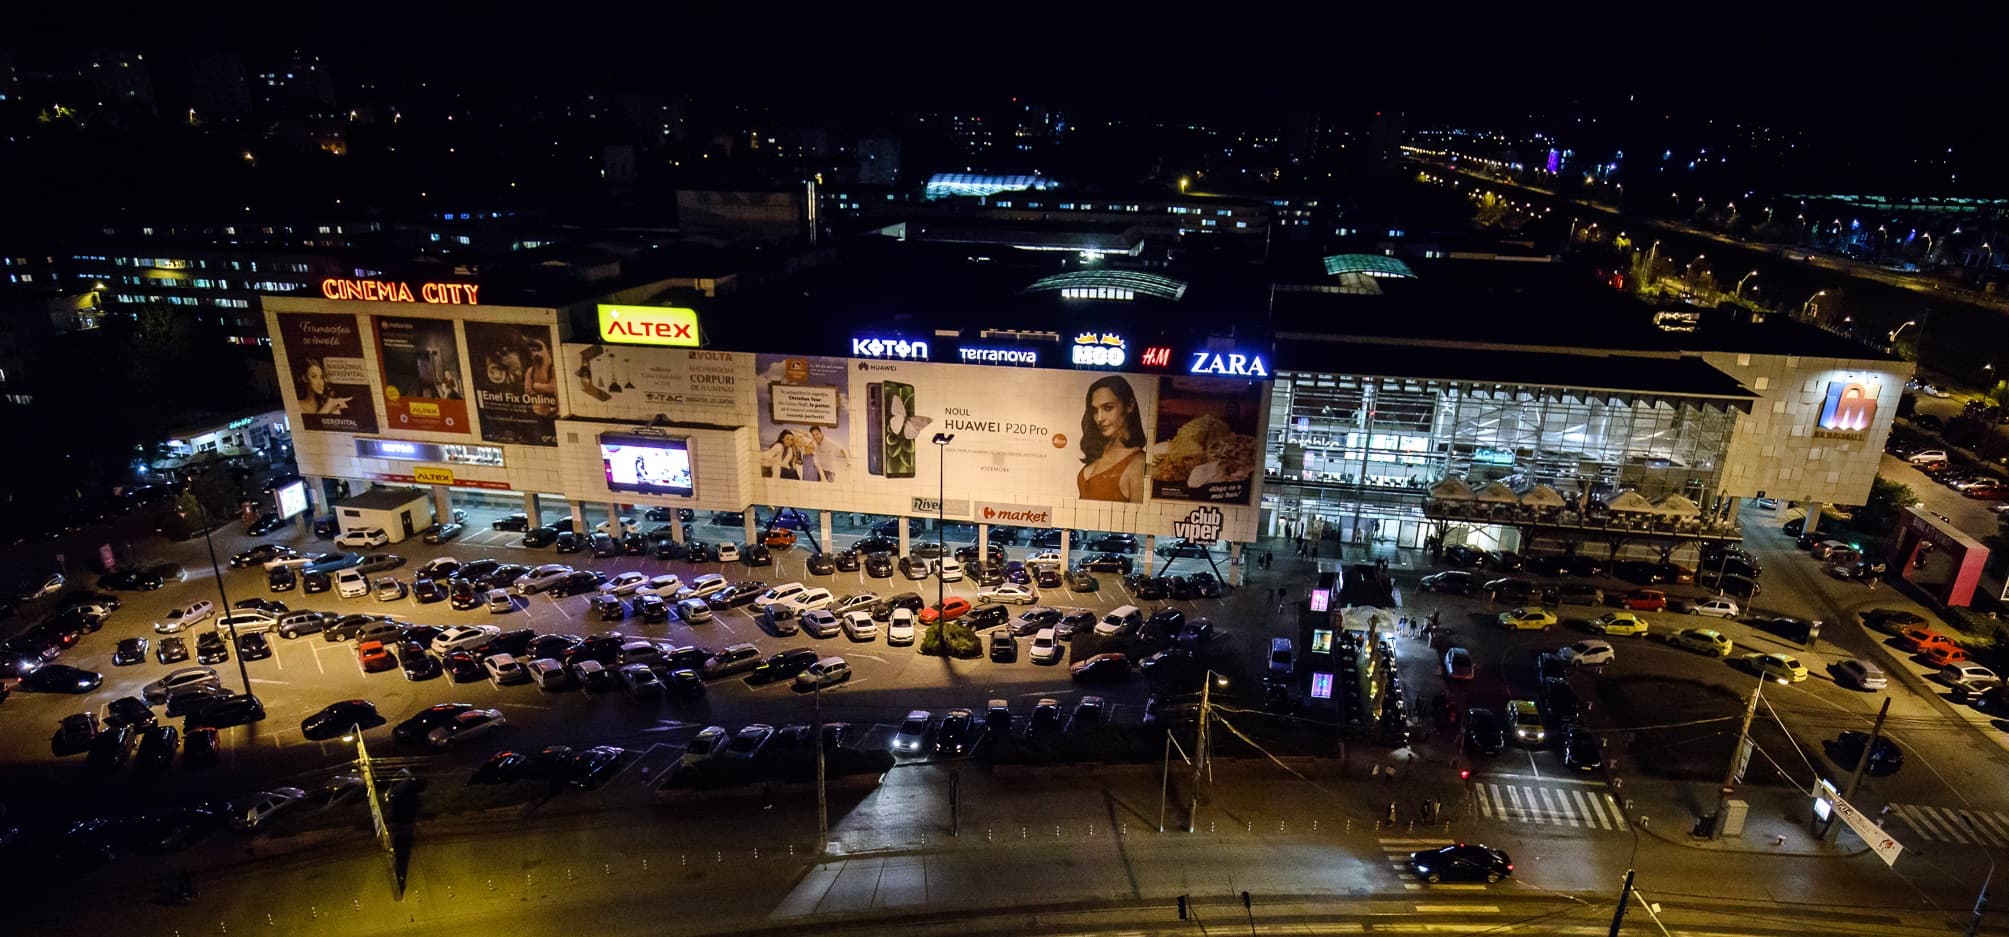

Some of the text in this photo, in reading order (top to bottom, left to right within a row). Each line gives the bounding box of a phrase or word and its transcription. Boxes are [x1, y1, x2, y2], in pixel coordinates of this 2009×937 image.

[323, 278, 479, 305] CINEMA CITY
[852, 338, 928, 360] KOTON
[870, 364, 897, 373] HUAWEI
[1191, 352, 1268, 376] ZARA
[689, 374, 735, 385] CORPURI
[483, 390, 556, 405] Enel Fix Online
[944, 407, 970, 417] NOUL
[944, 419, 1048, 436] HUAWEI P20 Pro
[998, 509, 1049, 523] market
[1190, 507, 1221, 525] club
[1175, 522, 1220, 544] viper
